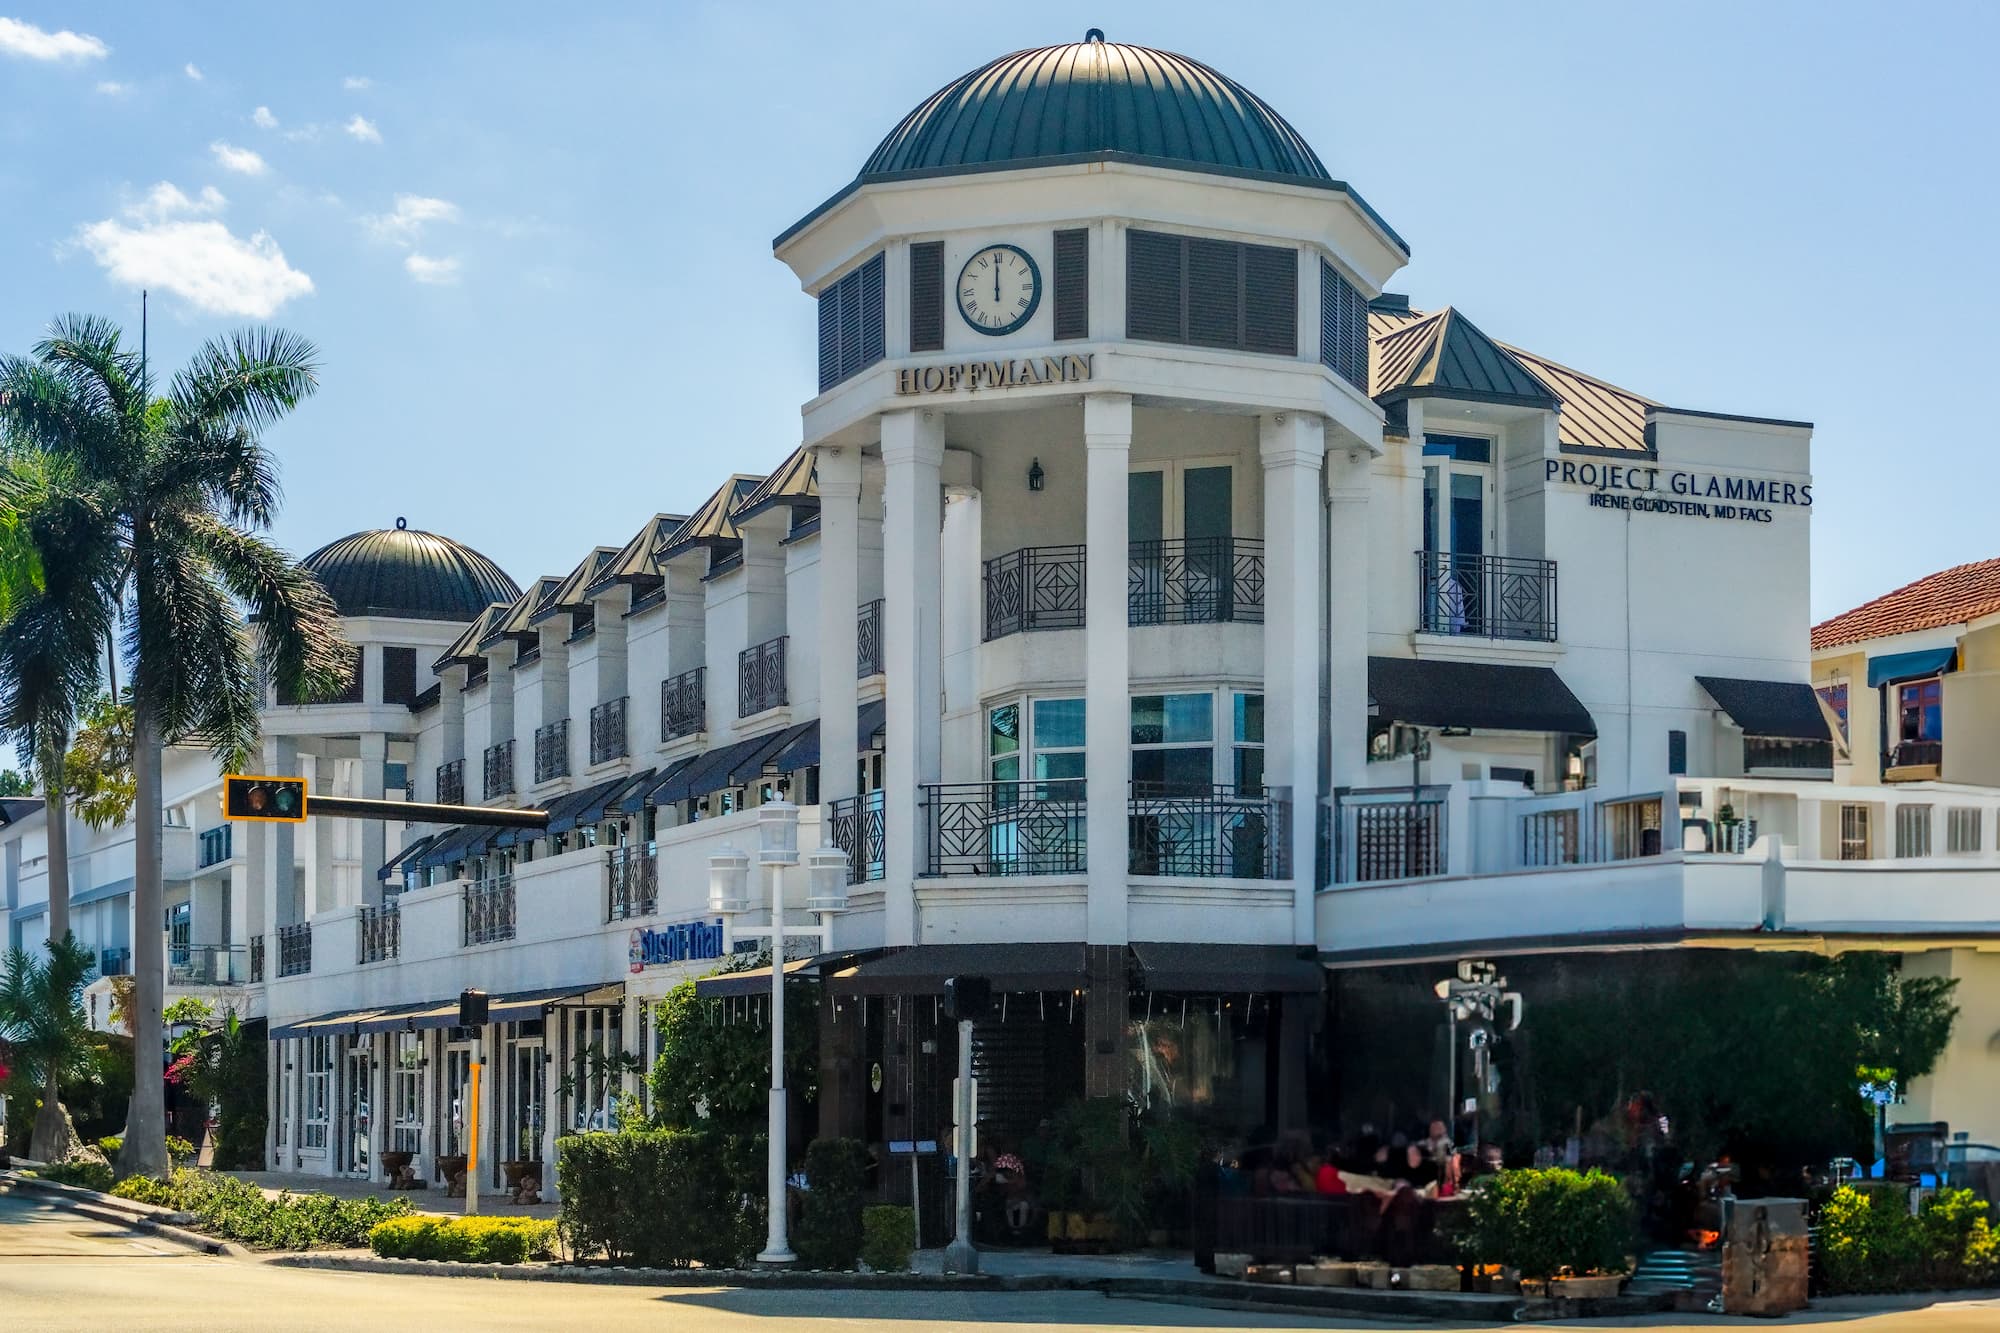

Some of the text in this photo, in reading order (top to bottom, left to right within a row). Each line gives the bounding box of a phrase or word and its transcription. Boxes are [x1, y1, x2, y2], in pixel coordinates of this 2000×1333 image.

[894, 353, 1094, 395] HOFFMANN
[1545, 459, 1814, 507] PROJECT GLAMMERS
[1589, 493, 1630, 510] IRENE
[1714, 505, 1736, 520] MD
[1740, 507, 1773, 523] FACS
